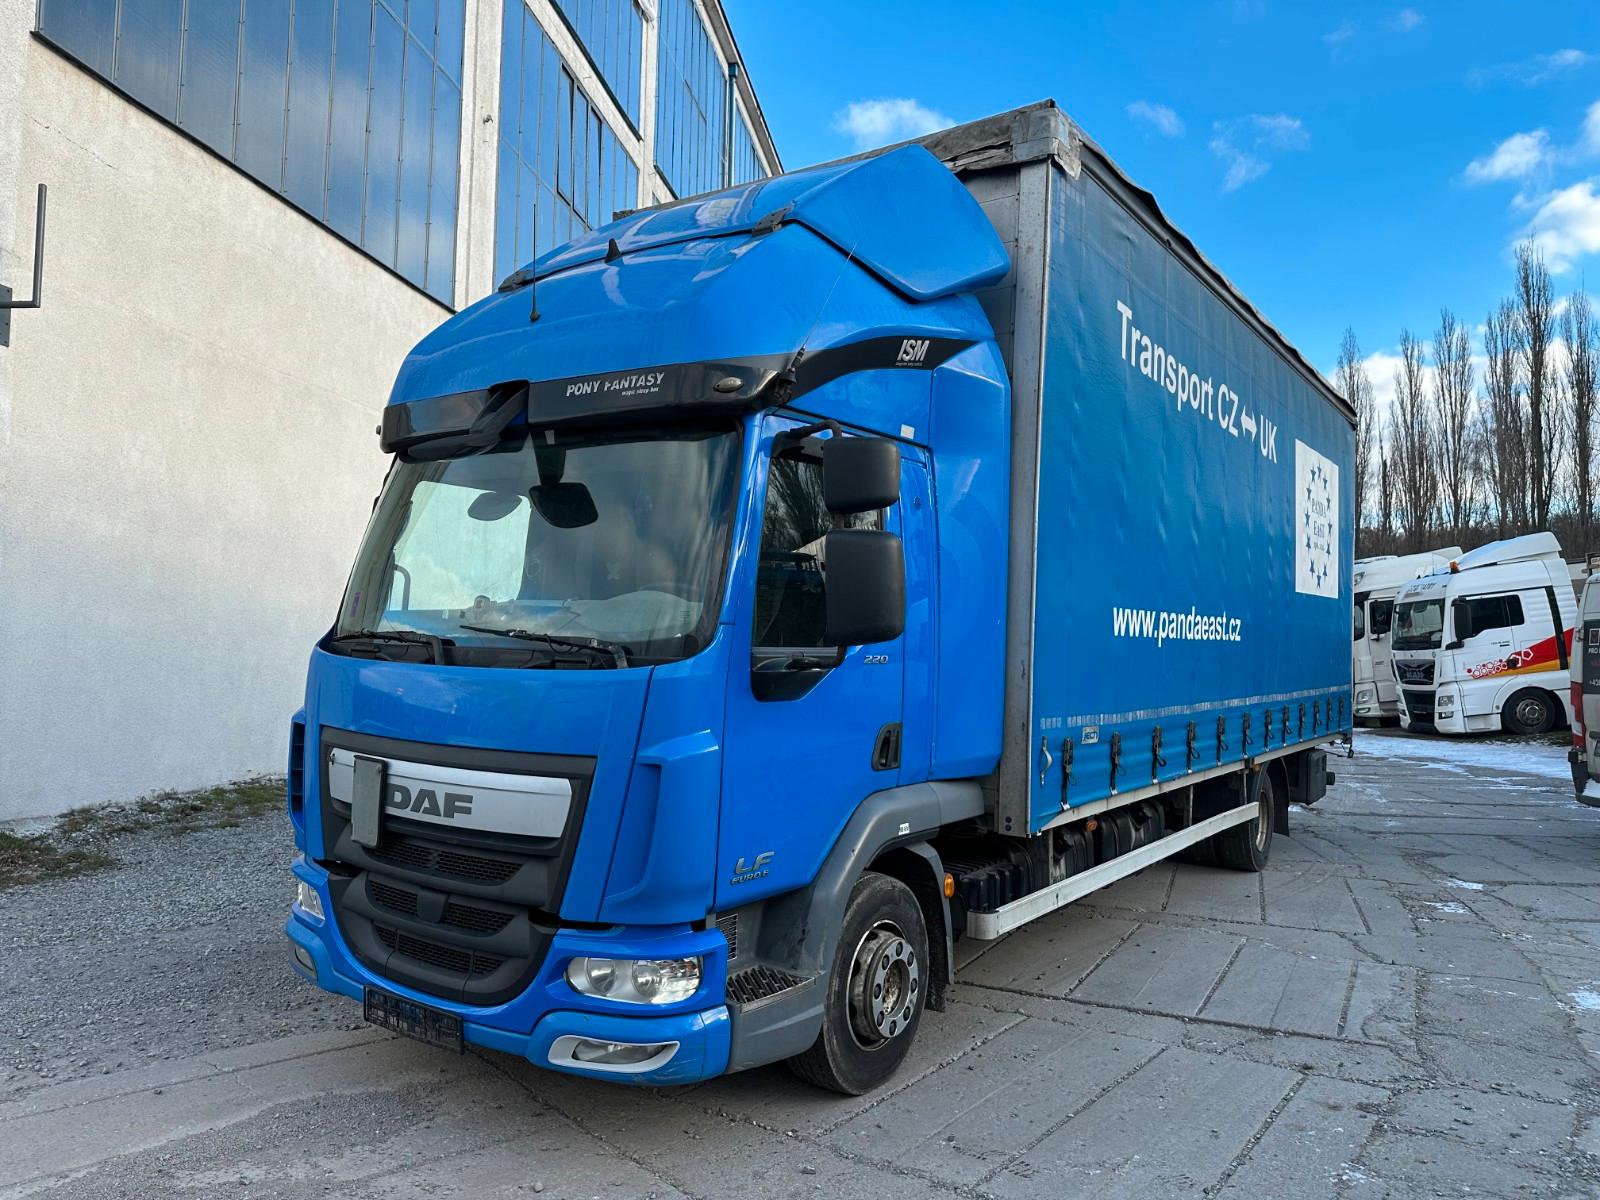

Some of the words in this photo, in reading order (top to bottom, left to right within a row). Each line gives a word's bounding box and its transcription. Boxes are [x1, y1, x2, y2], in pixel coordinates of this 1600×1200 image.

[897, 339, 930, 361] ISM
[566, 380, 601, 397] PONY
[604, 372, 665, 392] FANTASY
[1117, 300, 1213, 421] Transport
[1218, 383, 1239, 438] CZ
[1260, 414, 1278, 464] UK
[1311, 498, 1327, 518] PANDA
[1113, 605, 1242, 648] www.pandaeast.cz
[864, 655, 889, 664] 220
[386, 782, 474, 819] DAF
[735, 851, 775, 875] LF
[731, 871, 761, 885] EURO
